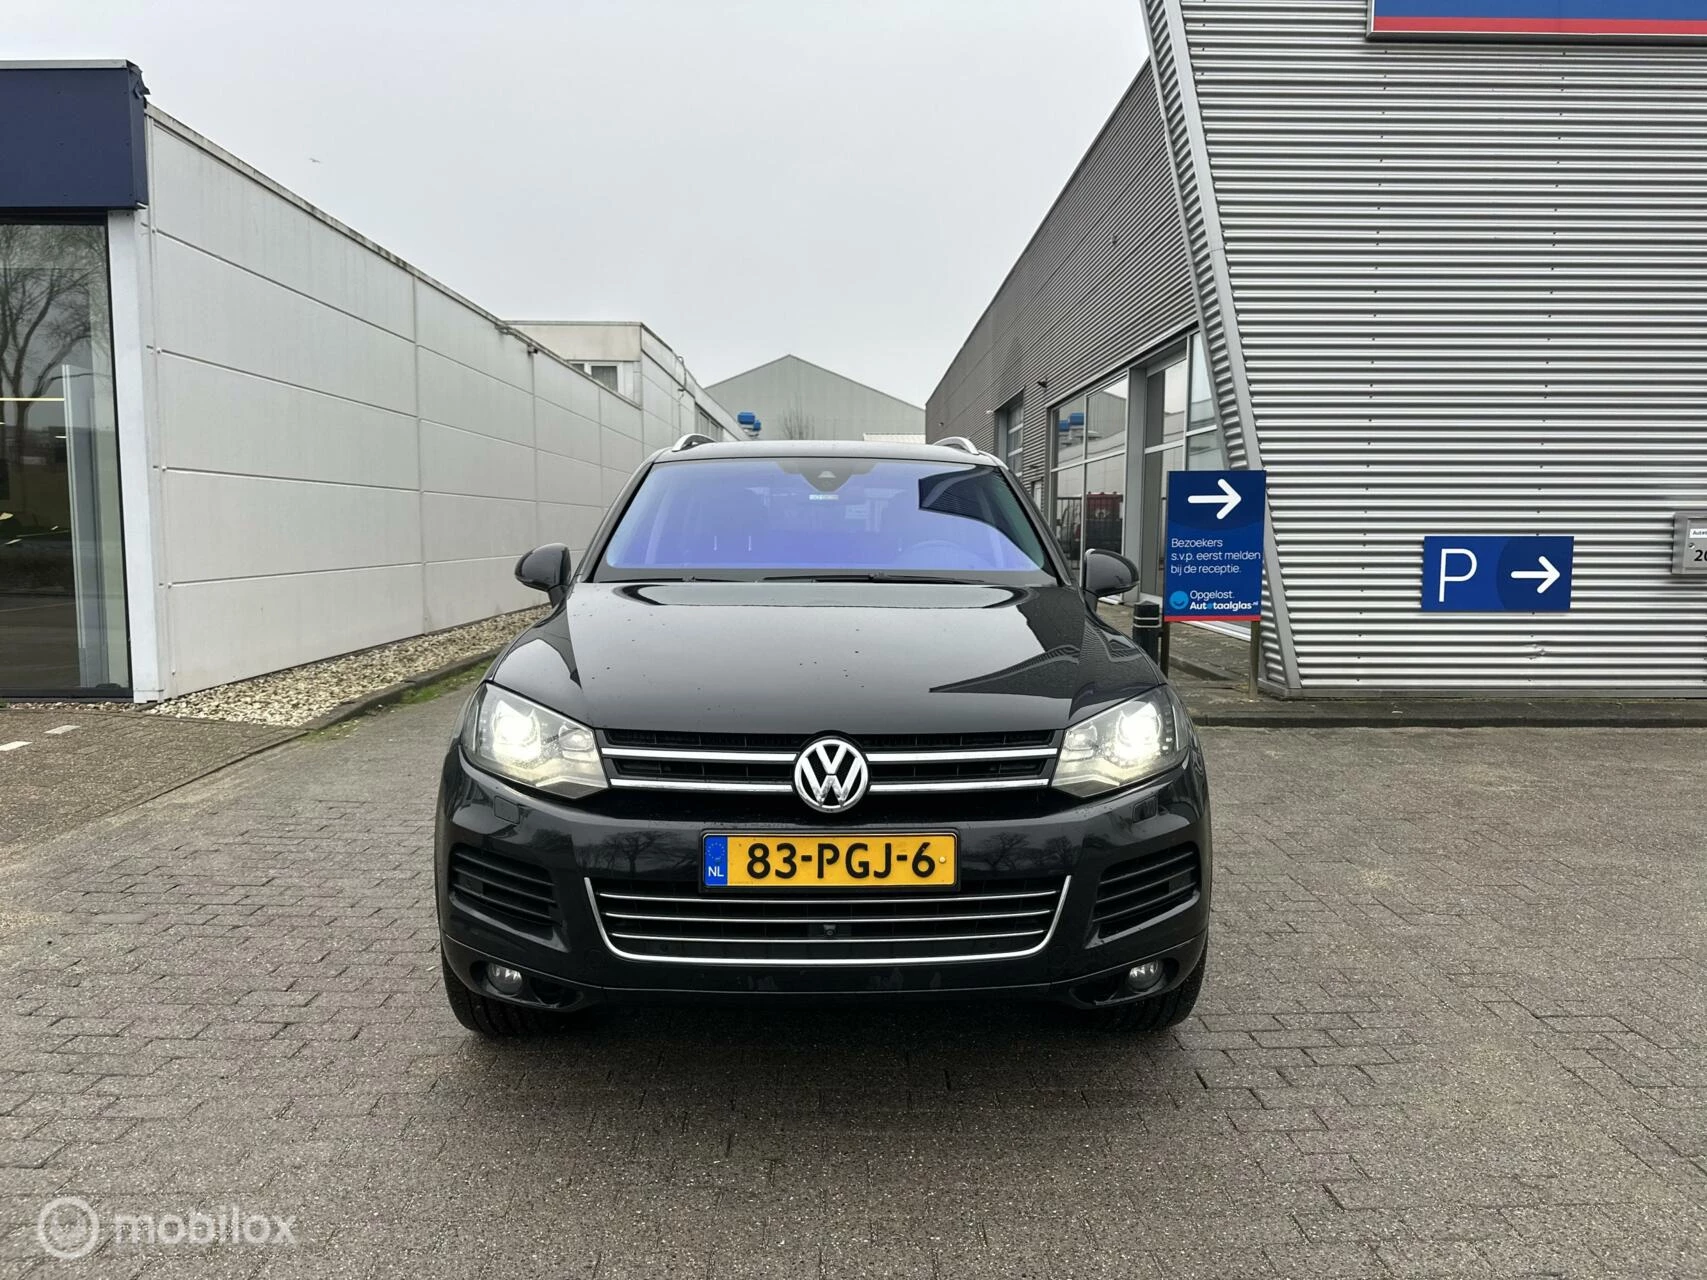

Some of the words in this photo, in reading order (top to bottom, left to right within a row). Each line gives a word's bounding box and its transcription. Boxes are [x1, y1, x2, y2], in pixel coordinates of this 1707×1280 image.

[1171, 538, 1223, 548] Bezoekers
[1171, 552, 1194, 562] s.v.p.
[1196, 552, 1223, 560] eerst
[1224, 551, 1261, 560] melden
[1170, 564, 1182, 576] bij
[1183, 564, 1197, 574] de
[1198, 564, 1242, 575] receptie.
[1438, 548, 1478, 602] P
[746, 842, 936, 880] 83-PGJ-6
[708, 865, 725, 877] NL
